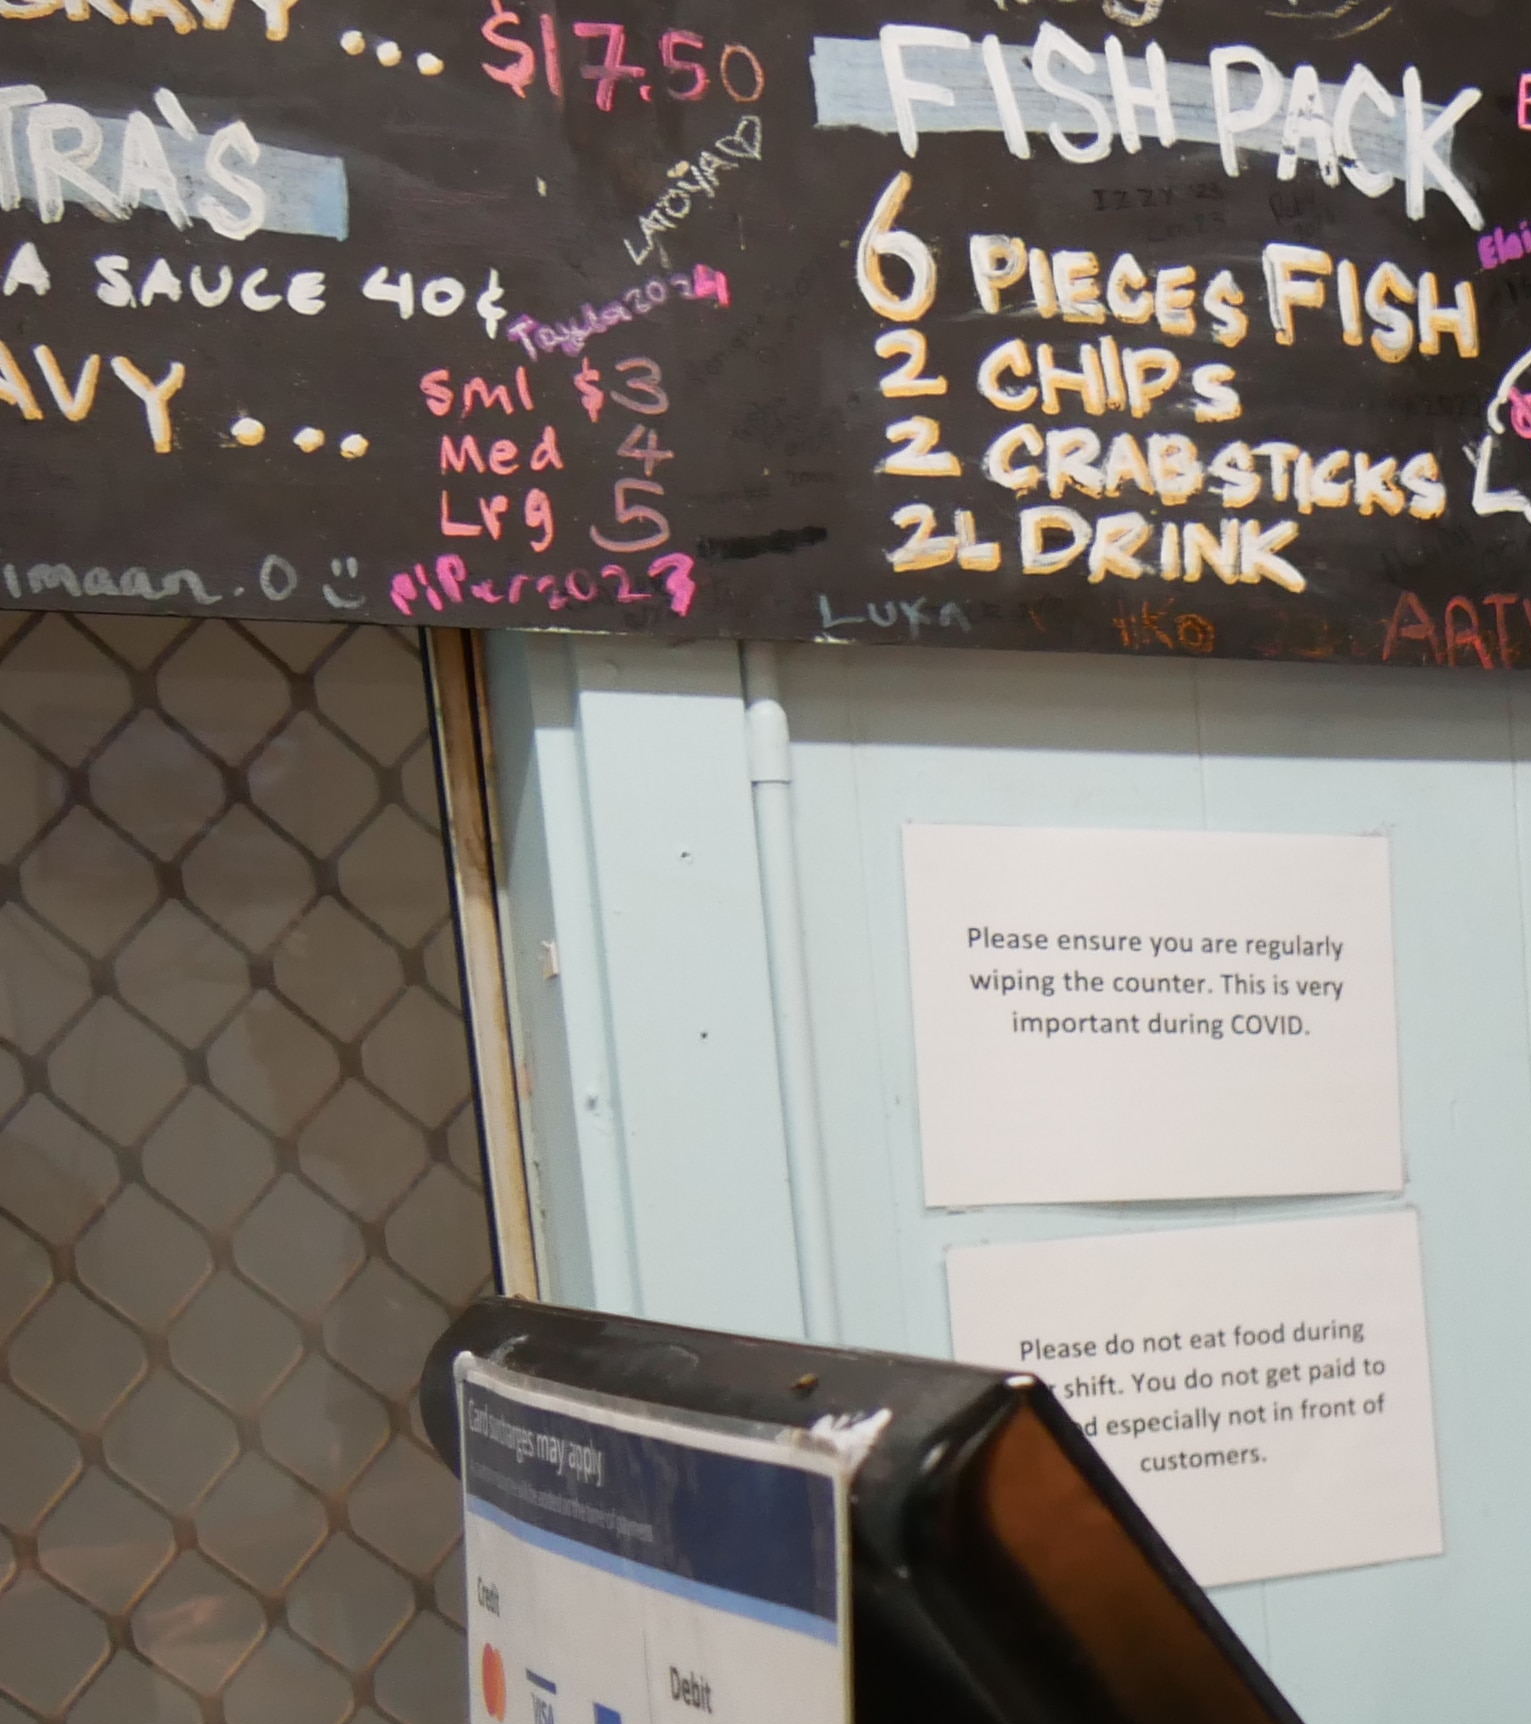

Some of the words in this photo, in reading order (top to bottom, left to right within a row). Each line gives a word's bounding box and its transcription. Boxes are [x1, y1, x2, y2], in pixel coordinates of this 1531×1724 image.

[481, 0, 764, 111] $17.50
[878, 21, 1178, 164] FISH
[1208, 44, 1486, 230] PACK
[95, 254, 327, 315] SAUCE
[856, 170, 938, 322] 6
[968, 233, 1249, 348] PIECES
[1261, 241, 1481, 363] FISH
[874, 328, 948, 398] 2
[977, 336, 1244, 423] CHIPS
[440, 426, 563, 475] Med
[616, 424, 675, 476] 4
[877, 415, 962, 478] 2
[590, 478, 670, 552] 5
[885, 502, 1001, 574] 2L
[1019, 504, 1307, 592] DRINK
[967, 926, 1049, 951] Please
[1056, 933, 1142, 953] ensure
[1149, 934, 1194, 958] you
[1200, 936, 1239, 955] are
[1245, 934, 1344, 961] regularly
[969, 969, 1056, 997] wiping
[1063, 970, 1104, 993] the
[1112, 973, 1214, 995] counter.
[1220, 972, 1266, 997] This
[1272, 975, 1290, 996] is
[1296, 978, 1344, 1001] very
[1011, 1011, 1141, 1040] important
[1147, 1012, 1224, 1040] during
[1230, 1013, 1312, 1037] COVID.
[1020, 1334, 1098, 1362] Please
[1104, 1333, 1135, 1356] do
[1141, 1331, 1182, 1354] not
[1188, 1329, 1227, 1350] eat
[1232, 1322, 1287, 1347] food
[1292, 1319, 1366, 1344] during
[1063, 1373, 1125, 1399] shift.
[1131, 1371, 1177, 1395] You
[1184, 1368, 1214, 1391] do
[1220, 1366, 1261, 1388] not
[1265, 1363, 1302, 1389] get
[1307, 1358, 1357, 1386] paid
[1363, 1356, 1387, 1377] to
[1105, 1407, 1221, 1439] especially
[1227, 1404, 1267, 1426] not
[1272, 1402, 1294, 1423] in
[1300, 1396, 1357, 1420] front
[1362, 1394, 1386, 1416] of
[535, 1433, 565, 1476] may
[568, 1437, 604, 1488] apply
[1139, 1446, 1268, 1473] customers.
[669, 1665, 714, 1715] Debit
